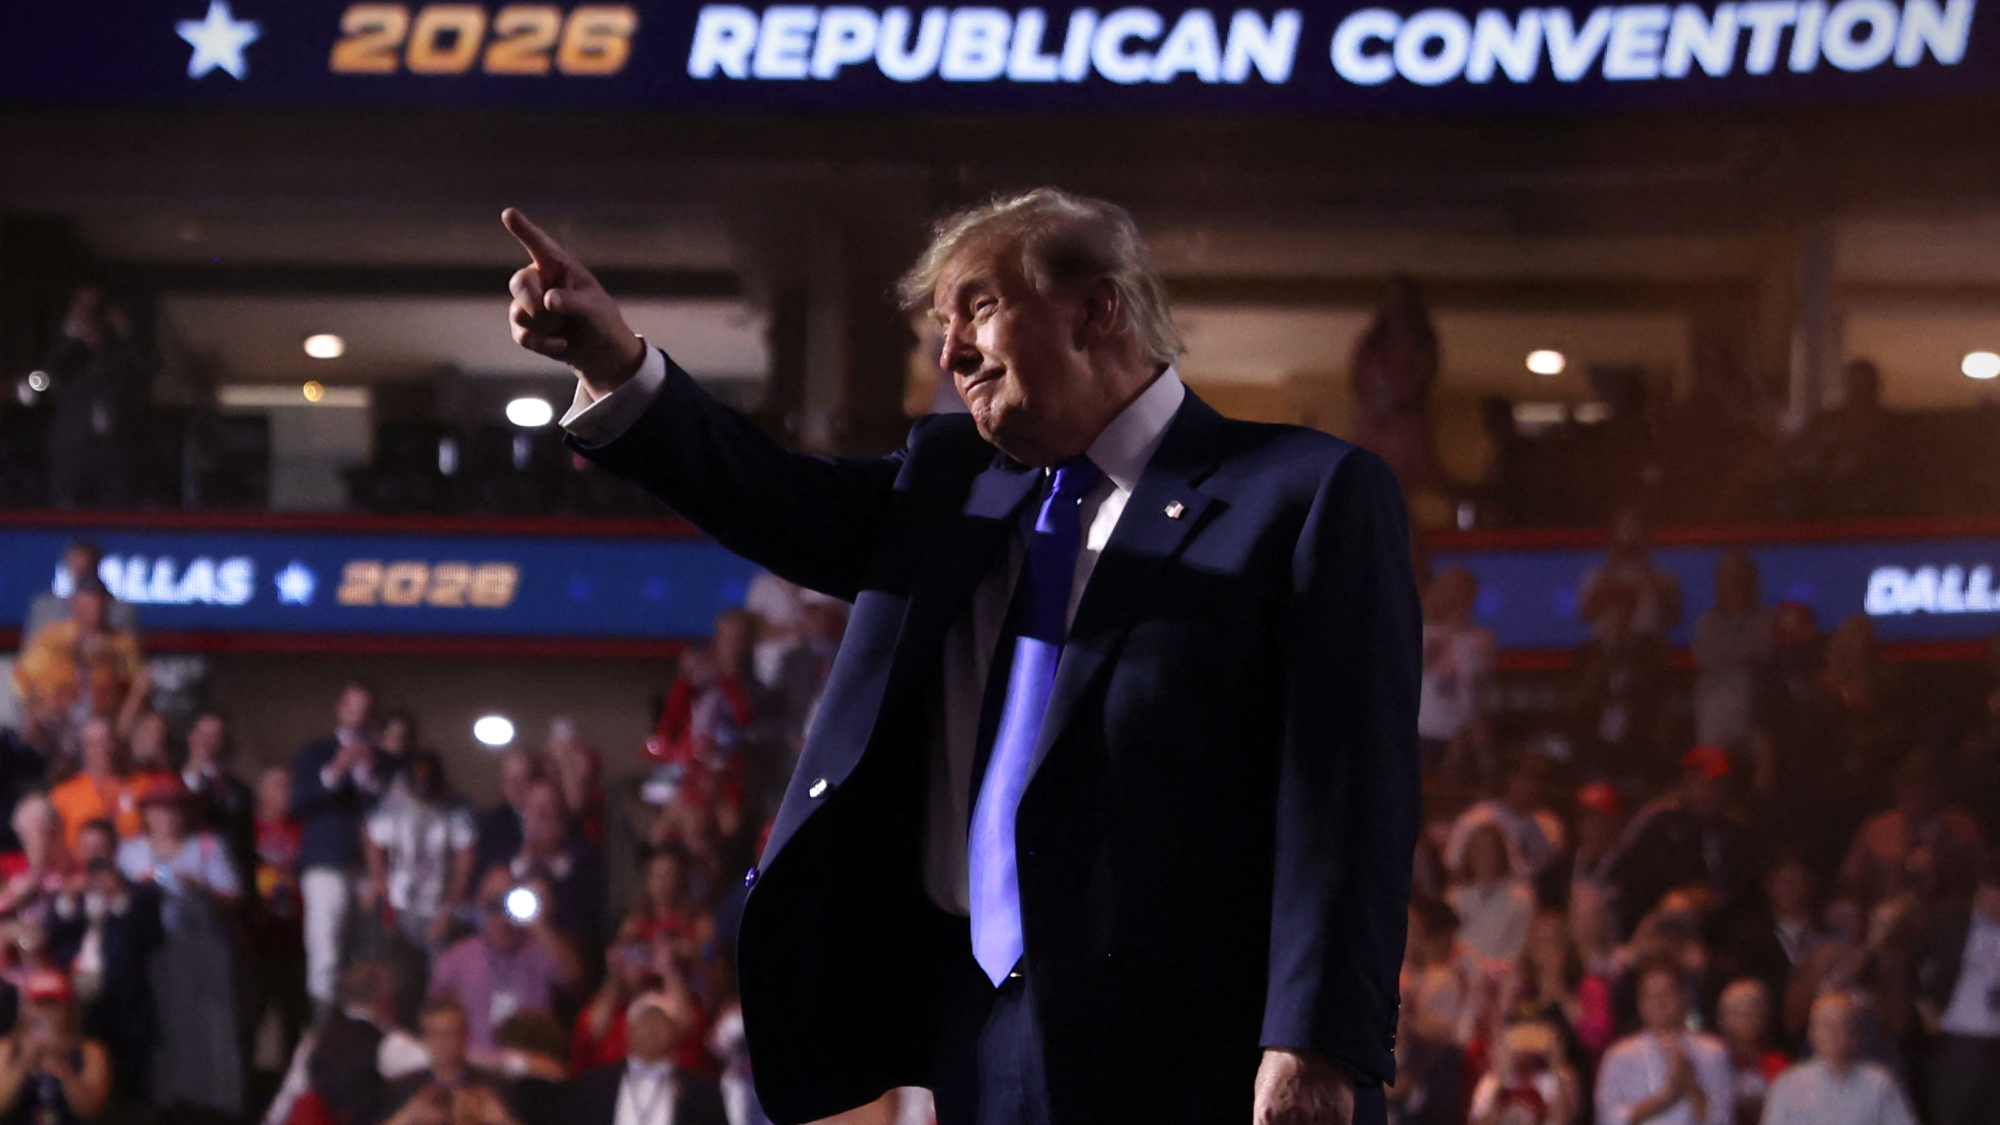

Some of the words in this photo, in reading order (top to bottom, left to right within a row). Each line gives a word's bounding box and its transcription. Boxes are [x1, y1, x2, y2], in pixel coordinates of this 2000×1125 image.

[331, 4, 637, 74] 2026
[688, 5, 1300, 83] REPUBLICAN
[1330, 0, 1974, 85] CONVENTION
[1864, 565, 2000, 615] DALL
